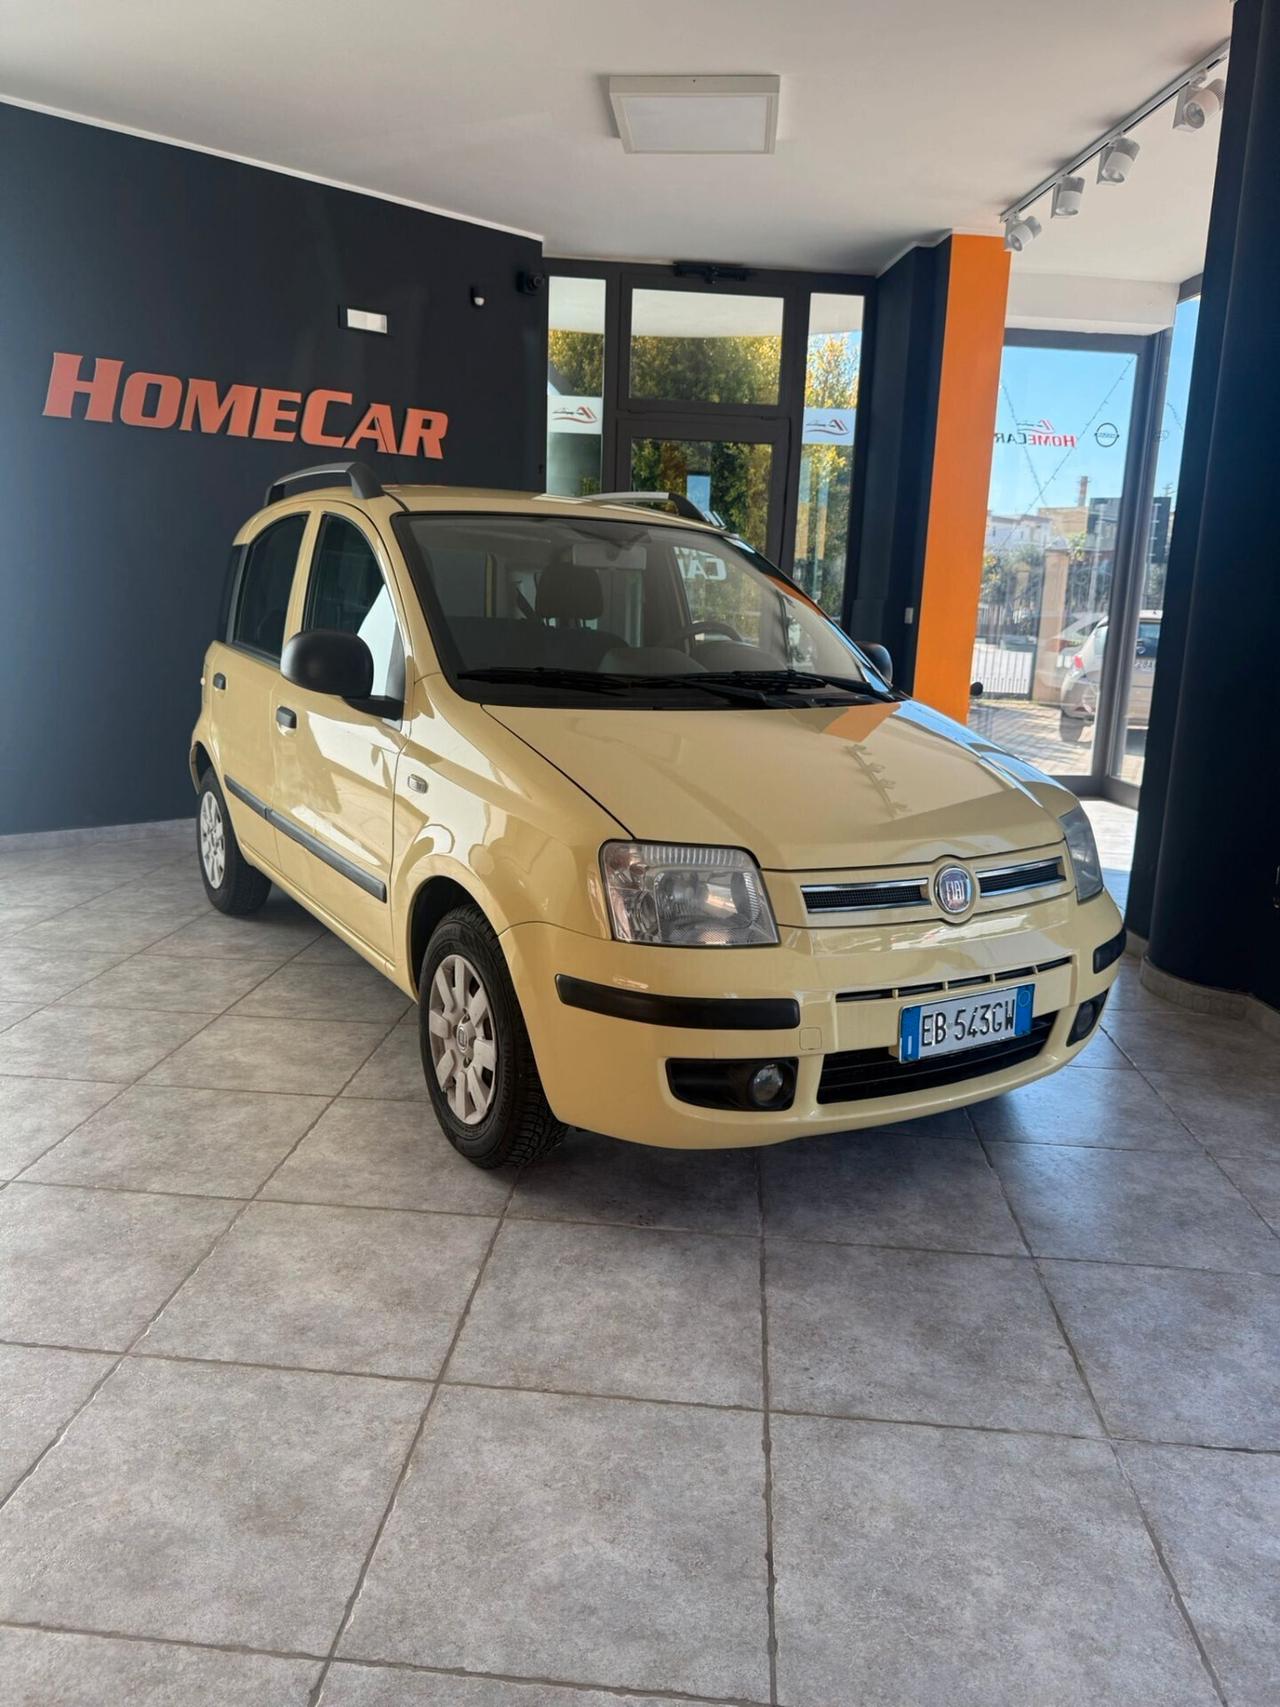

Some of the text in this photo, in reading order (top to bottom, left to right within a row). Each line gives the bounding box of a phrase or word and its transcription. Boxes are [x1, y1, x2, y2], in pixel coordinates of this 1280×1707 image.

[42, 352, 449, 459] HOMECAR
[945, 880, 965, 901] FIAT
[921, 1012, 947, 1047] EB
[954, 999, 1016, 1041] 543GW
